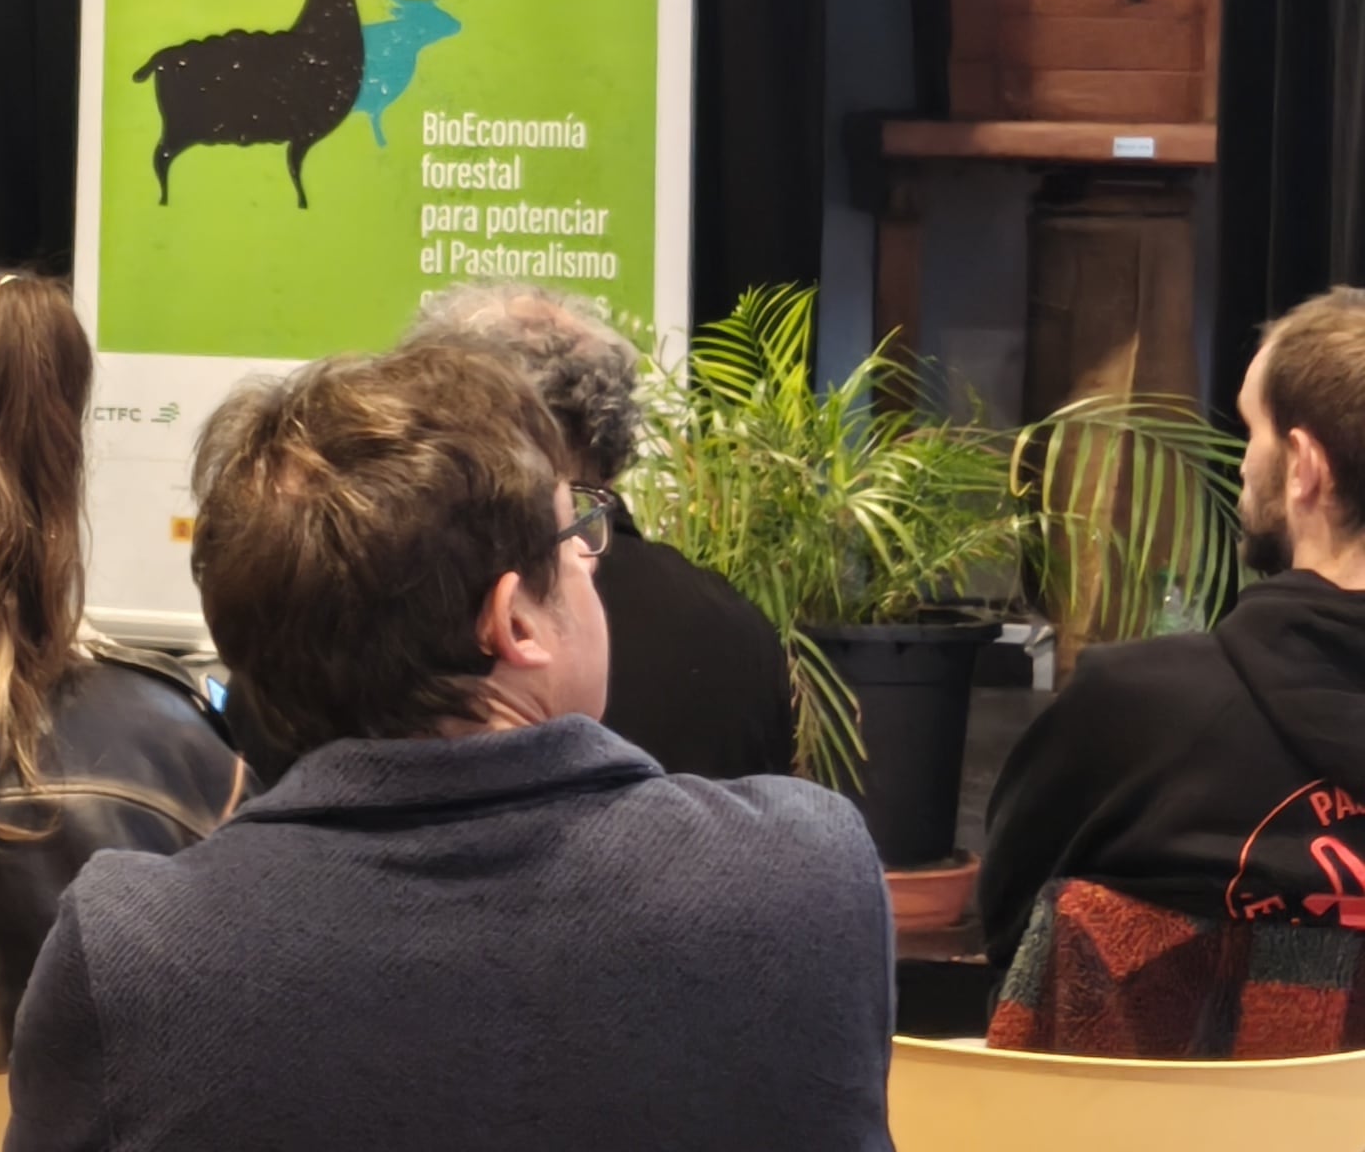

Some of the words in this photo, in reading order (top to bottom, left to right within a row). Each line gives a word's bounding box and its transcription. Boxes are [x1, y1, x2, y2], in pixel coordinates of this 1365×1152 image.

[422, 110, 587, 149] BioEconomía
[421, 152, 522, 190] forestal
[421, 203, 478, 239] para
[486, 198, 609, 239] potenciar
[420, 238, 443, 274] el
[449, 239, 617, 279] Pastoralismo
[93, 407, 142, 423] CTFC
[1309, 786, 1365, 827] PA
